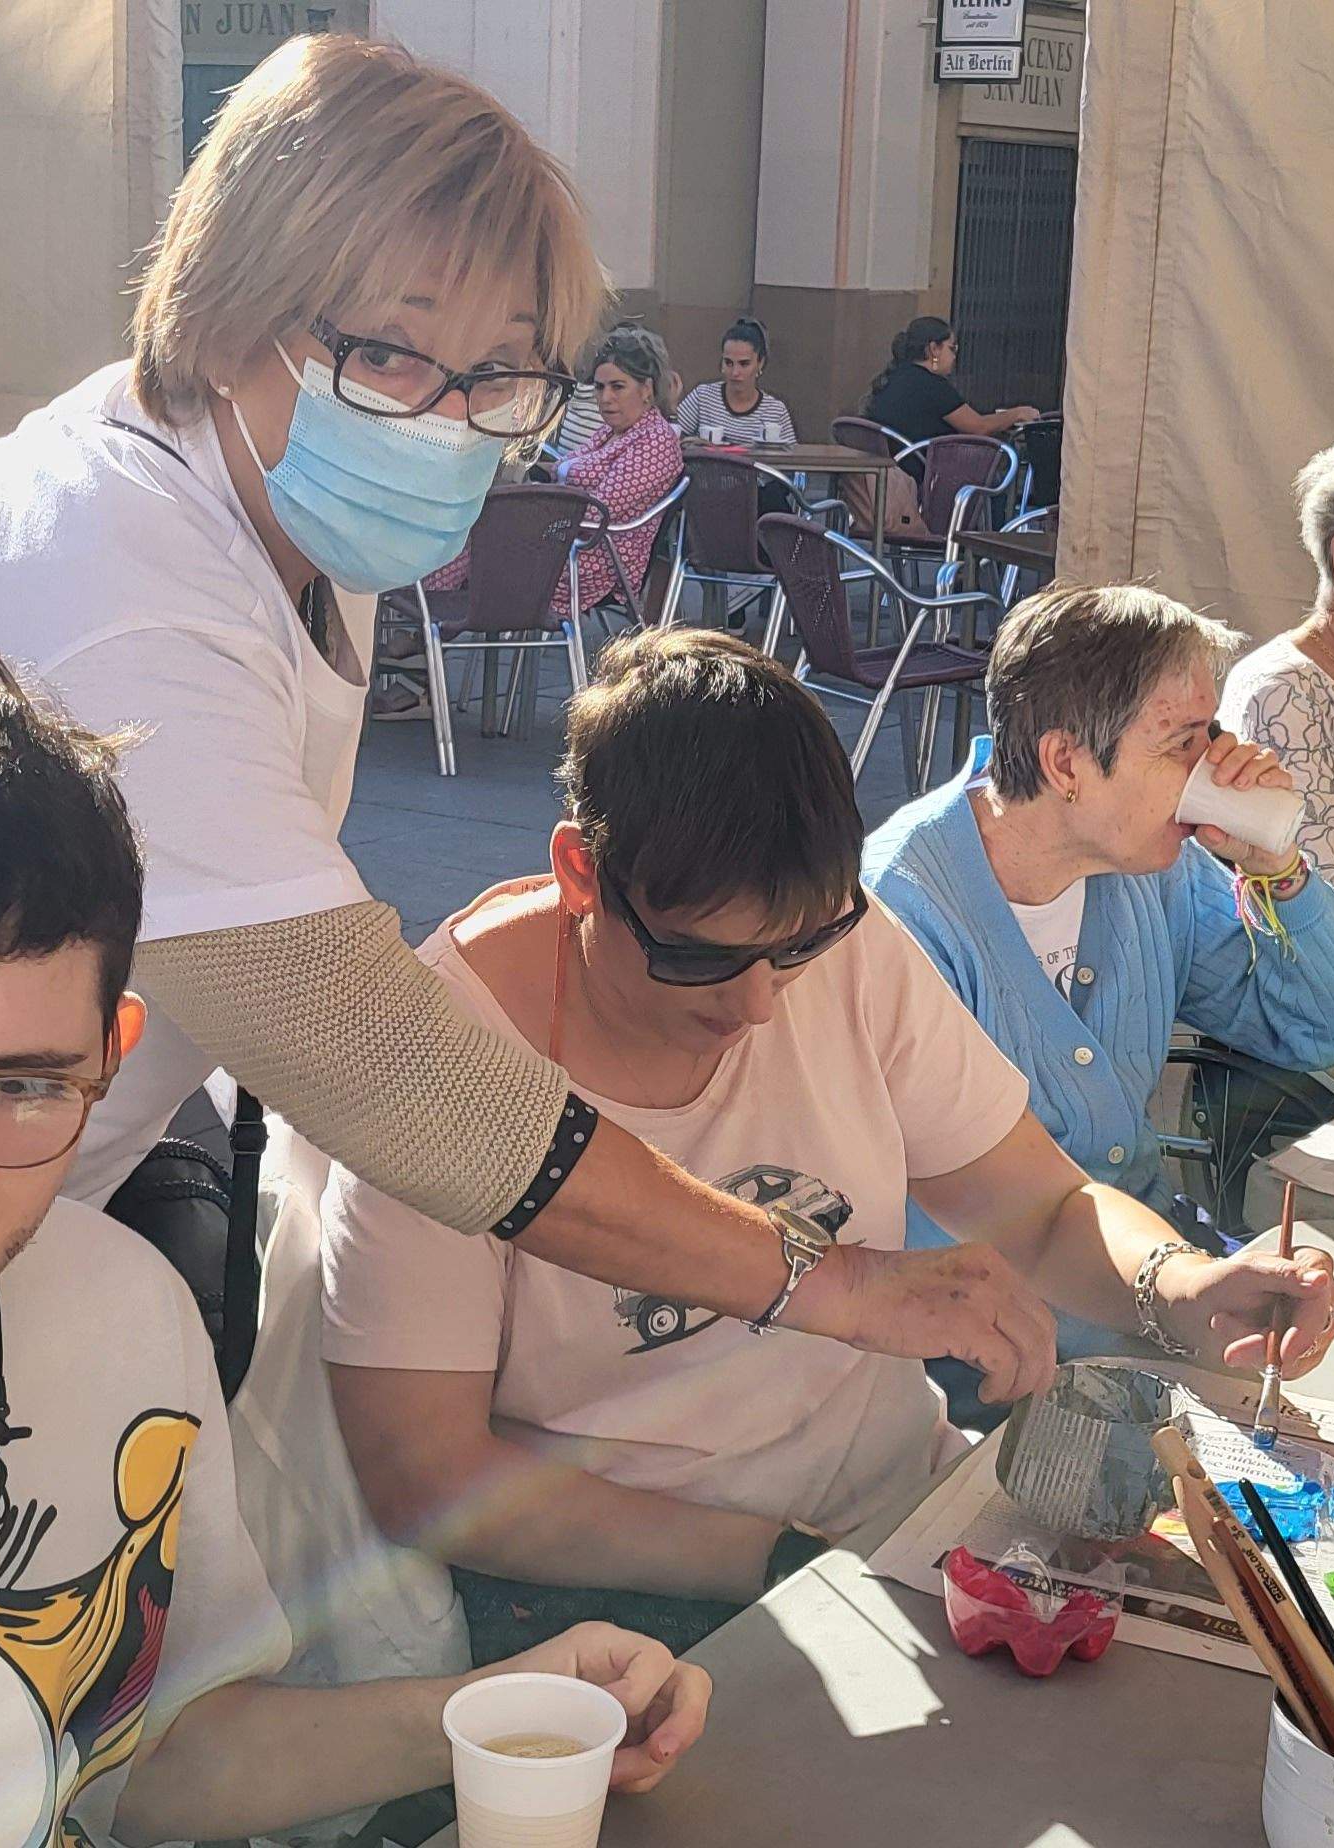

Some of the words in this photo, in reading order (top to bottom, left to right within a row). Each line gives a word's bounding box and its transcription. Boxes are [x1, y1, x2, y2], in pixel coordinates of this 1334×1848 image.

[217, 3, 295, 35] JUAN
[944, 53, 964, 71] Alt
[968, 53, 1012, 72] Berlin
[1020, 74, 1065, 107] JUAN
[1047, 950, 1060, 965] OF
